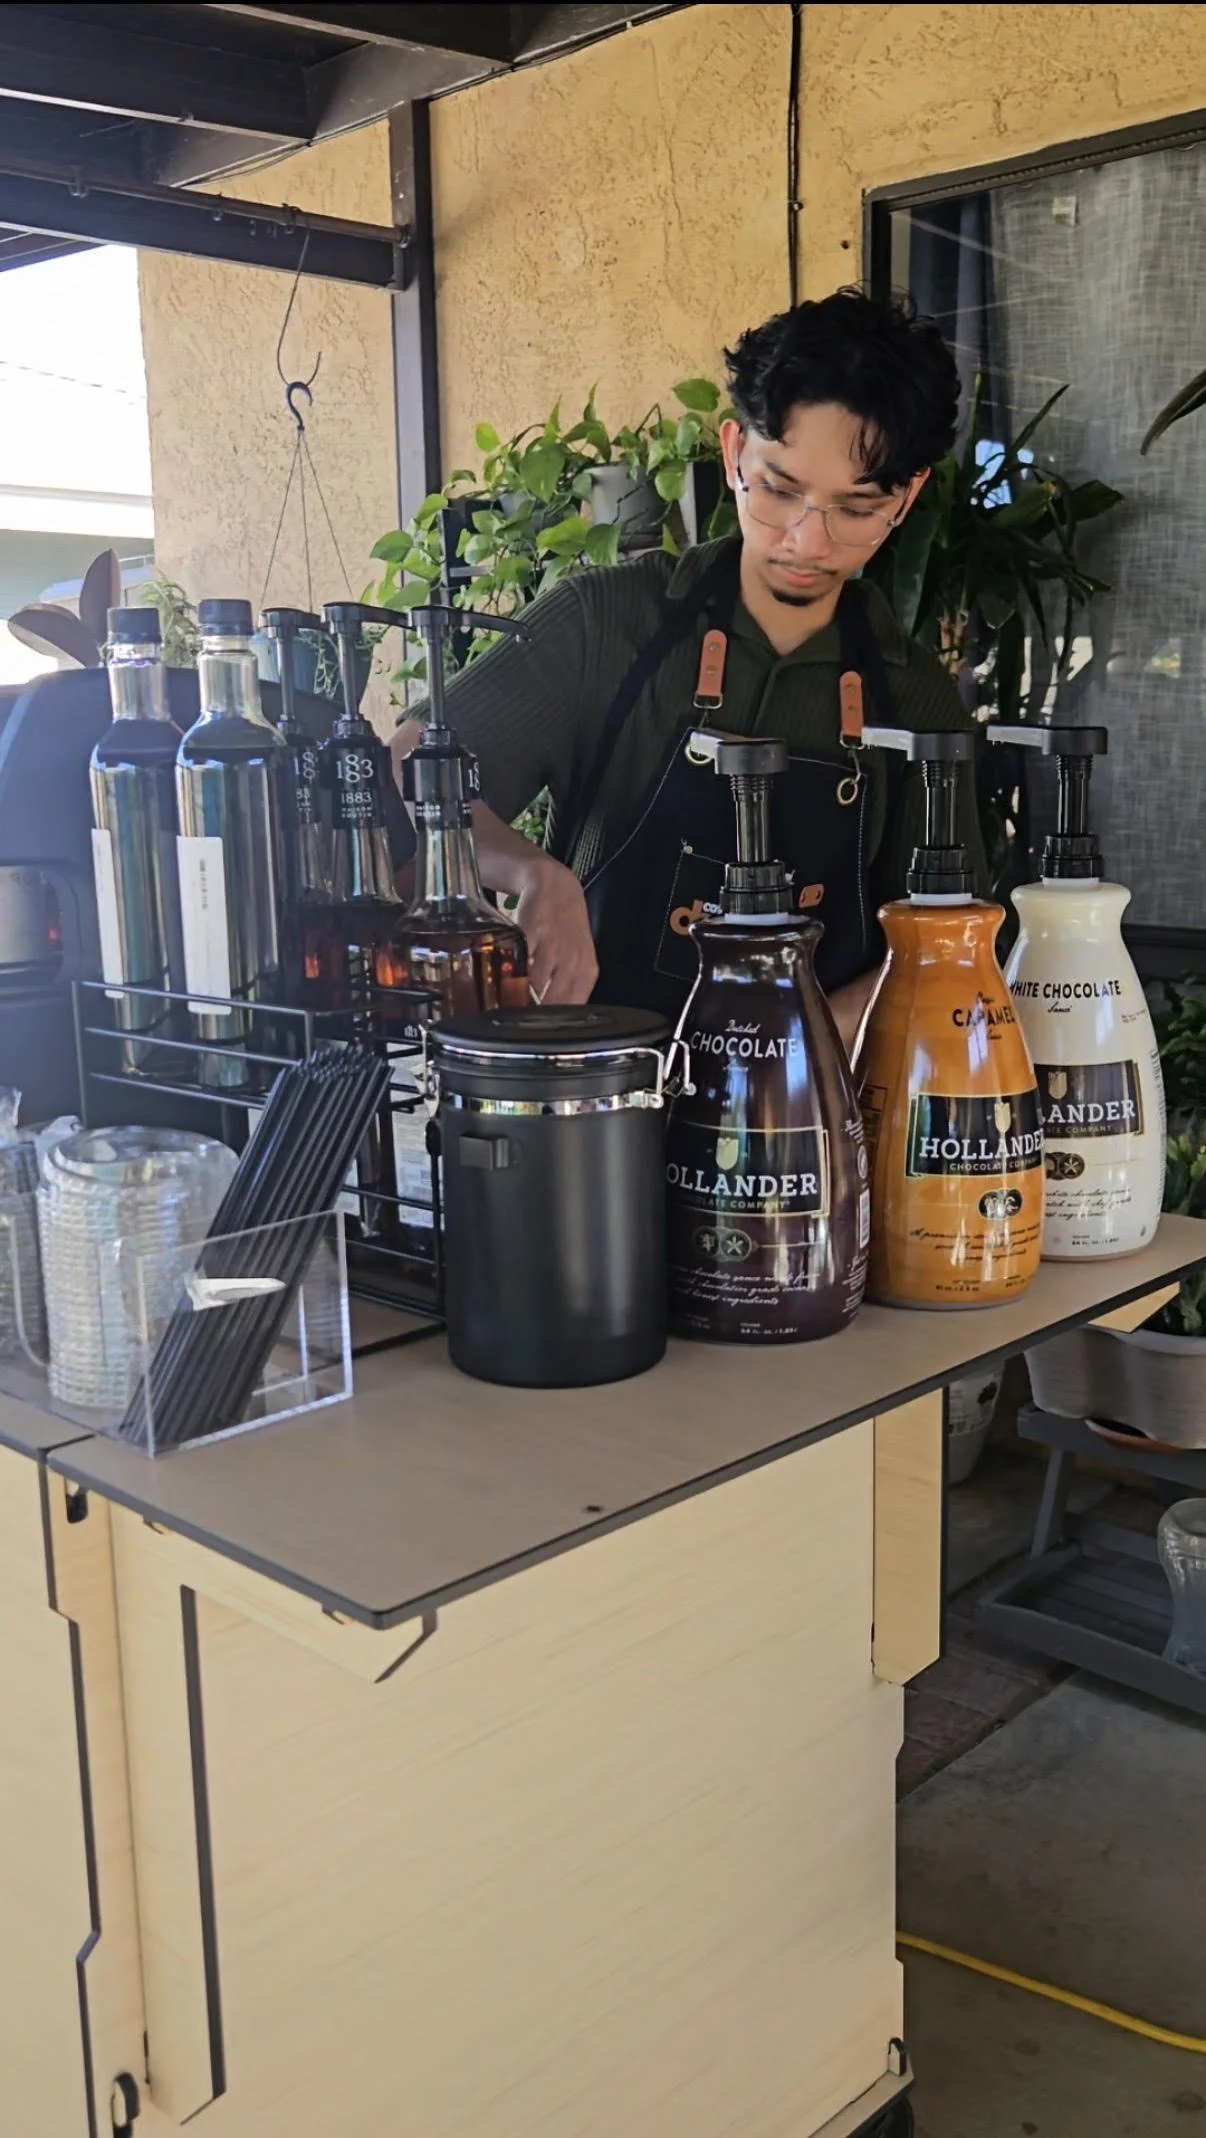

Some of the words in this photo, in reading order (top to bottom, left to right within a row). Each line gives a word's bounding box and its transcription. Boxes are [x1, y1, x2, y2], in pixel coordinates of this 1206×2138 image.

[341, 791, 372, 804] 1883
[1043, 980, 1121, 998] CHOCOLATE
[952, 1006, 1016, 1027] CARAMEL
[690, 1031, 798, 1059] CHOCOLATE
[949, 1162, 1006, 1172] CHOCOLAT
[667, 1163, 818, 1197] OLLANDER
